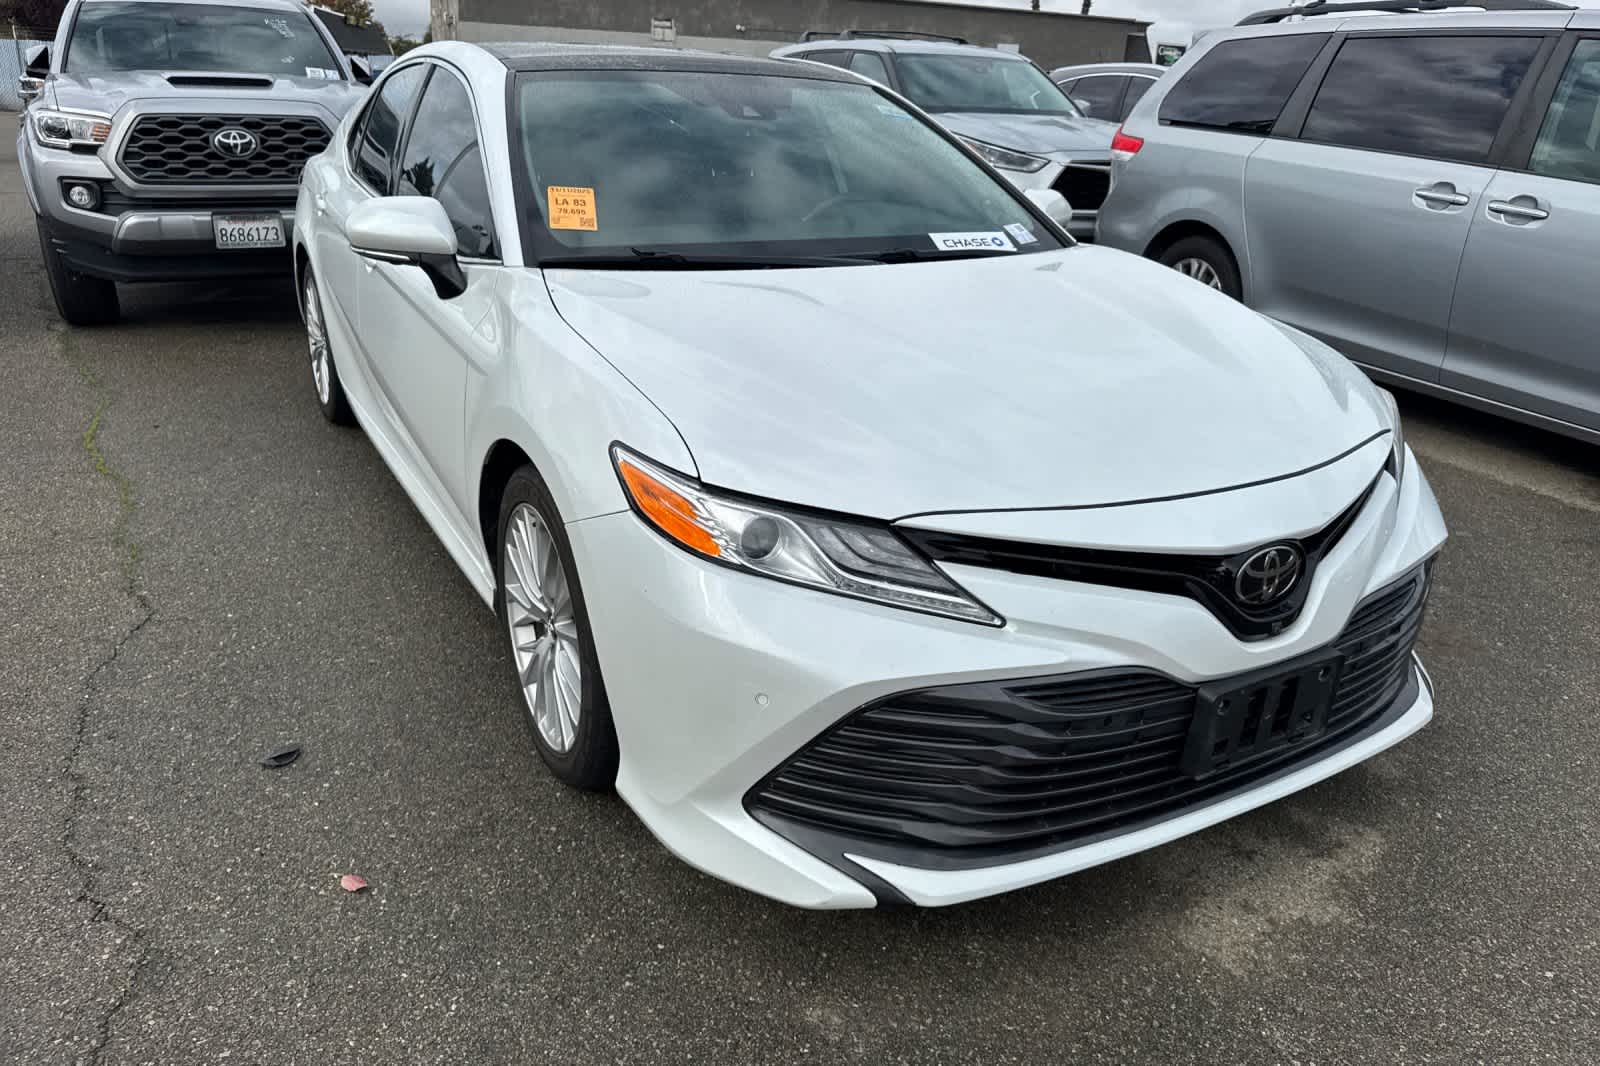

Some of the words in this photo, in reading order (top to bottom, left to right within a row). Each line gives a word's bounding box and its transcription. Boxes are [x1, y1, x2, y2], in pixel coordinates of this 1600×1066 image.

[555, 198, 569, 206] LA
[573, 199, 586, 207] 83
[219, 226, 280, 242] 8686173
[942, 238, 993, 248] CHASE
